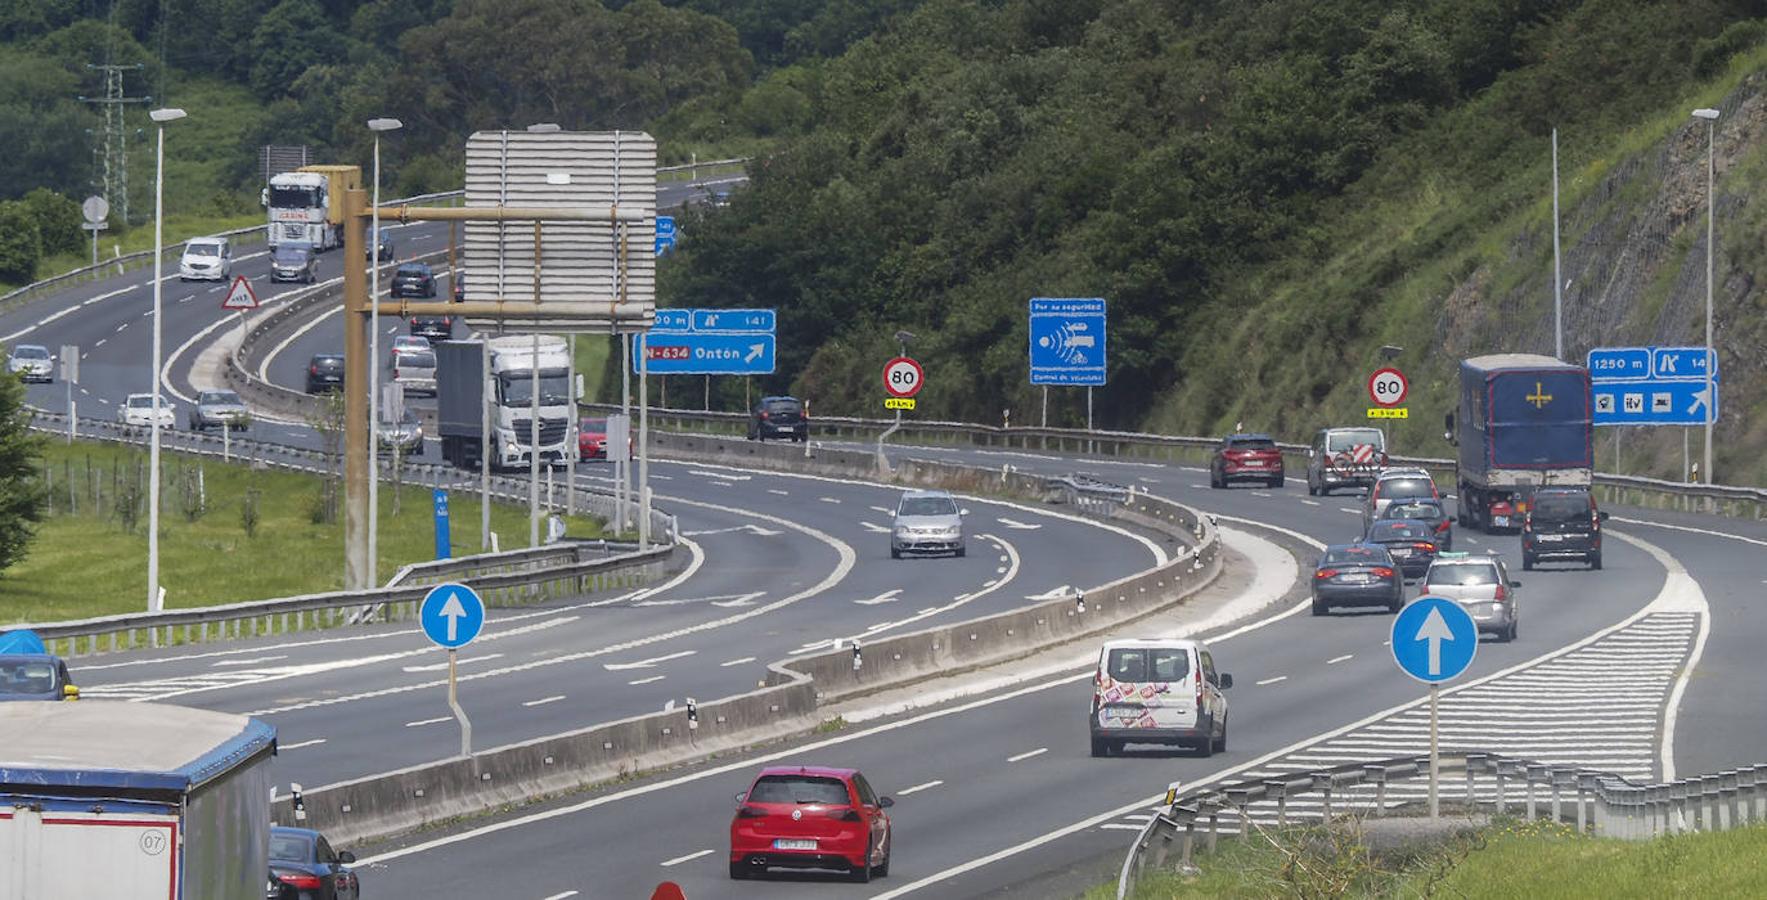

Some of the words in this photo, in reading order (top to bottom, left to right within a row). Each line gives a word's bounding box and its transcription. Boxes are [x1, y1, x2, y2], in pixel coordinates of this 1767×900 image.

[655, 316, 671, 325] 00
[695, 347, 740, 359] Ontón
[1594, 359, 1625, 369] 1250
[1692, 358, 1706, 368] 14
[892, 370, 914, 384] 80
[1377, 381, 1400, 394] 80
[144, 836, 161, 849] 07
